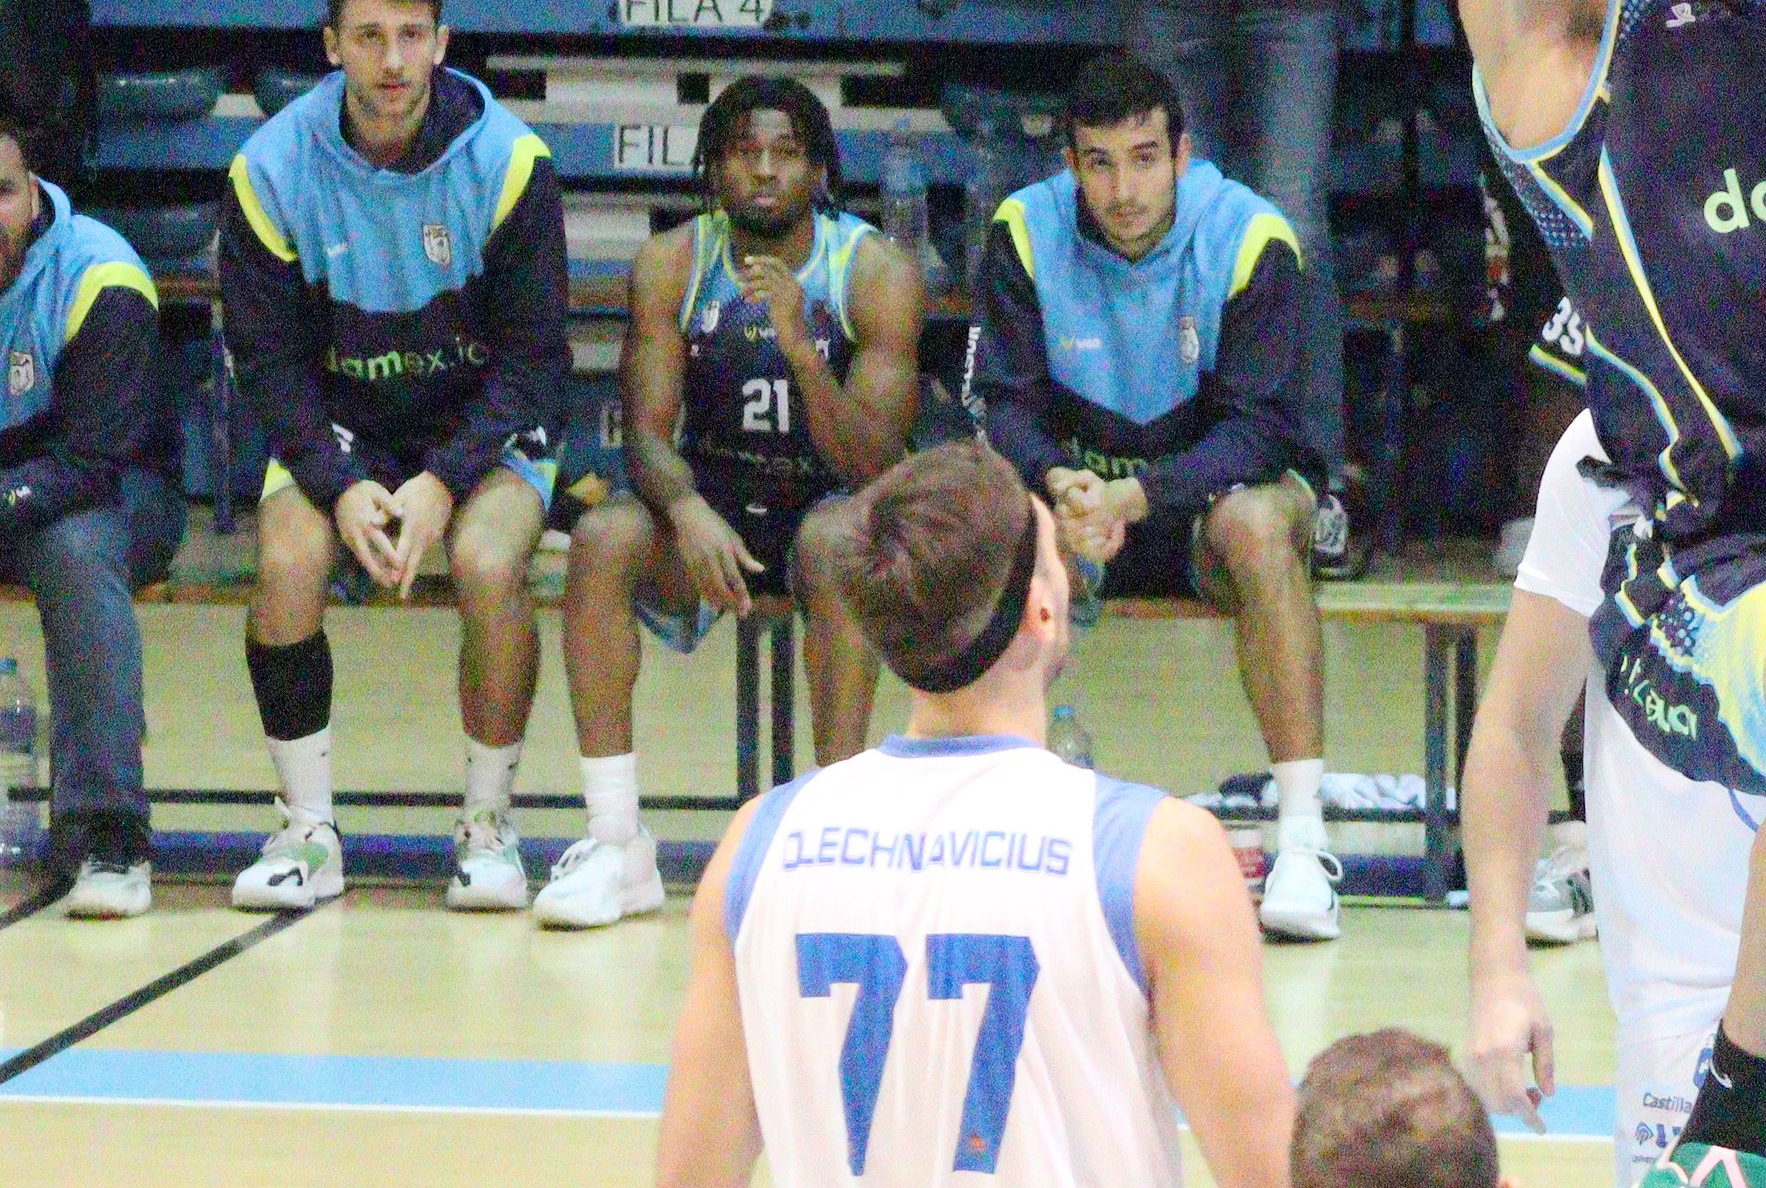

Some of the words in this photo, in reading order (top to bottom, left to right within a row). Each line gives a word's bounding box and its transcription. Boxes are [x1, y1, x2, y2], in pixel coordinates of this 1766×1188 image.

[1541, 296, 1585, 356] 35
[741, 378, 790, 433] 21
[794, 932, 1041, 1176] 77
[1642, 1092, 1694, 1113] Castilla
